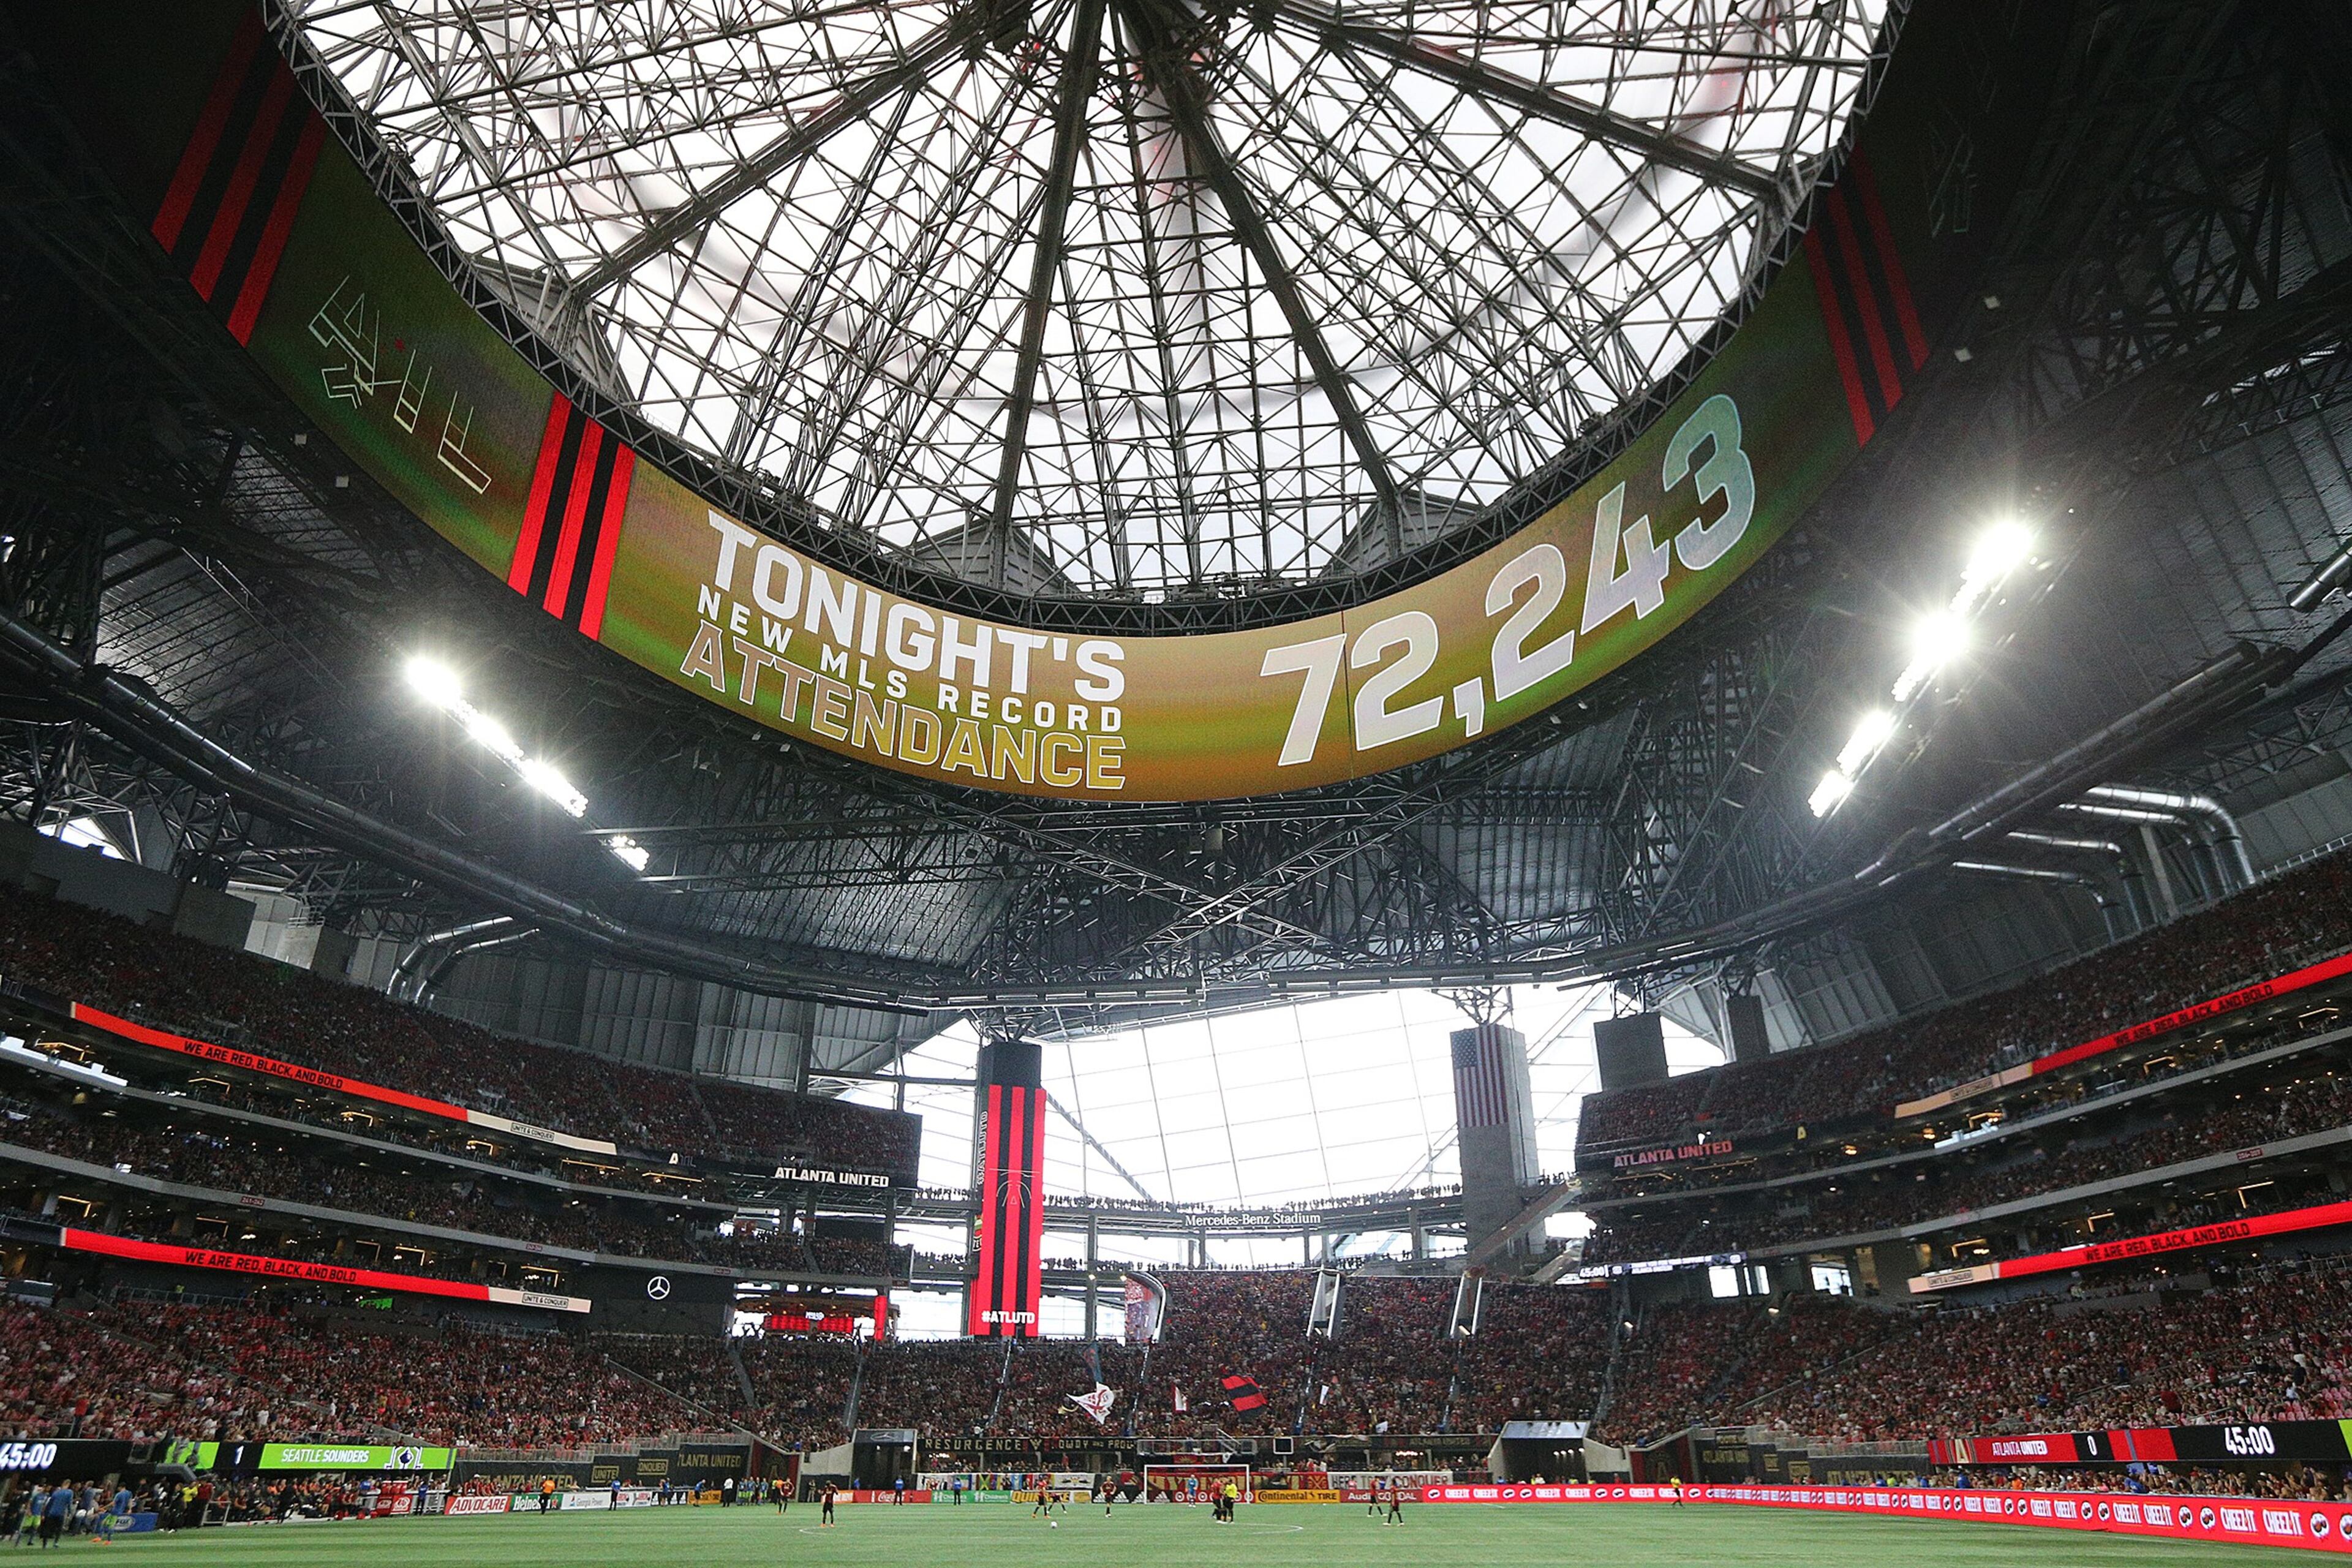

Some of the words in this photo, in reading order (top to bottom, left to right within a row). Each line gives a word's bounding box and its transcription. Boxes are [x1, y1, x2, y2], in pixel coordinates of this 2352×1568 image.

[1260, 394, 1755, 766] 72,243
[708, 509, 1126, 702] TONIGHT'S
[697, 584, 793, 654] NEW
[820, 643, 907, 699] MLS
[938, 683, 1121, 733] RECORD
[680, 619, 1126, 790] ATTENDANCE
[2218, 996, 2242, 1012] AND
[2242, 984, 2274, 1003] BOLD
[184, 1041, 202, 1055] WE
[205, 1047, 228, 1061] ARE
[295, 1069, 316, 1083] AND
[317, 1074, 344, 1089] BOLD
[1614, 1149, 1675, 1168] ATLANTA
[1677, 1140, 1733, 1159] UNITED
[774, 1167, 835, 1183] ATLANTA
[839, 1172, 889, 1187] UNITED
[1185, 1213, 1271, 1226] Mercedes-Benz
[1273, 1212, 1322, 1224] Stadium
[2085, 1249, 2100, 1262] WE
[2103, 1245, 2124, 1257] ARE
[2193, 1229, 2217, 1244] AND
[2218, 1223, 2252, 1240] BOLD
[185, 1251, 206, 1264] WE
[207, 1256, 233, 1268] ARE
[305, 1265, 328, 1279] AND
[329, 1268, 357, 1283] BOLD
[544, 1297, 567, 1306] CONQUER
[981, 1311, 1035, 1324] #ATLUTD
[925, 1439, 1022, 1451] RESURGENCE
[1108, 1440, 1135, 1449] PROU
[1992, 1441, 2021, 1457] ATLANTA
[2020, 1440, 2049, 1456] UNITED
[2087, 1435, 2098, 1457] 0
[2225, 1425, 2275, 1456] 45:00
[0, 1443, 58, 1469] 45:00
[235, 1446, 244, 1466] 1
[281, 1448, 323, 1463] SEATTLE
[322, 1450, 370, 1463] SOUNDERS
[711, 1455, 741, 1468] UNITED
[450, 1497, 507, 1514] ADVOCARE
[1258, 1490, 1308, 1503] Continental
[1317, 1491, 1338, 1501] TIRE
